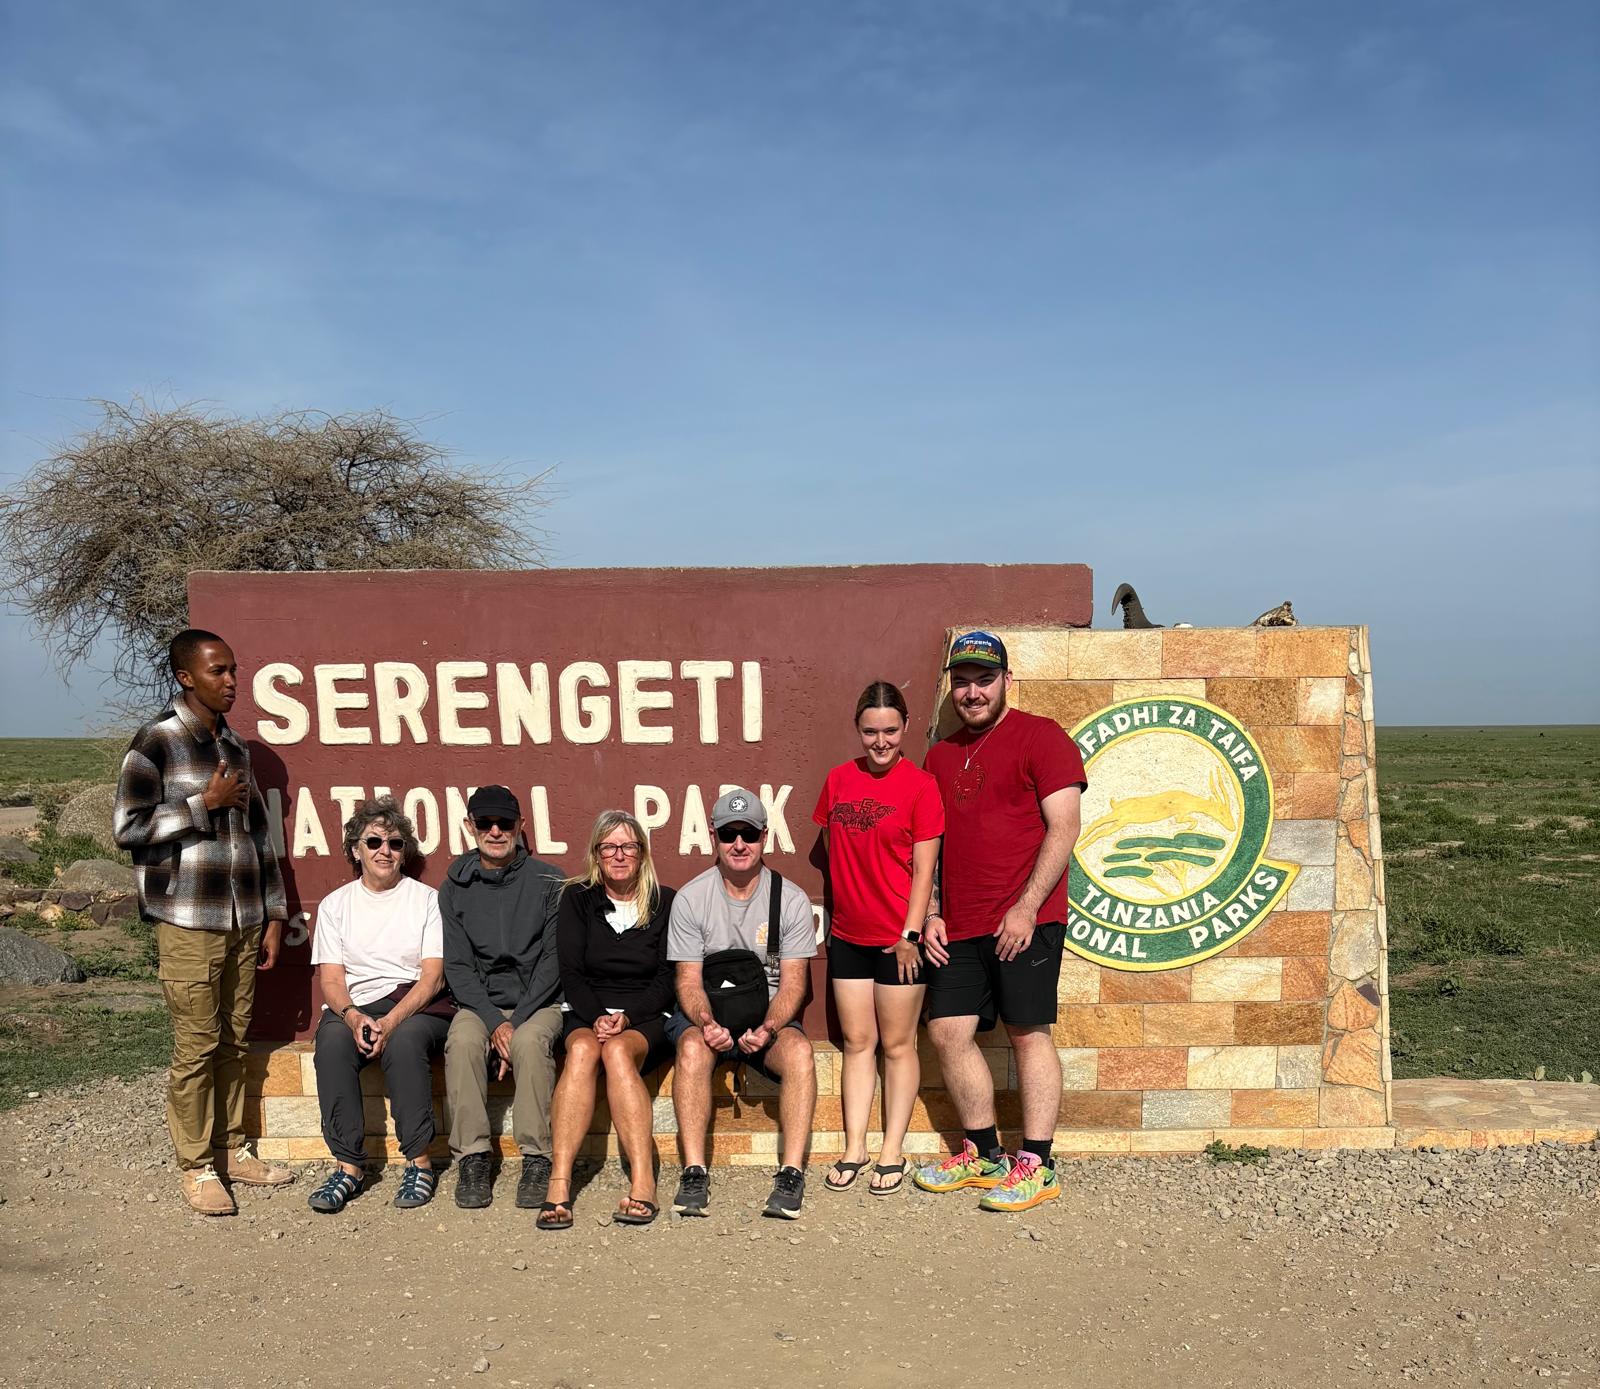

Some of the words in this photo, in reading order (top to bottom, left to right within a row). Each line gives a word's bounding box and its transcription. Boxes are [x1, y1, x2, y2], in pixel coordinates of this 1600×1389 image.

[252, 660, 764, 746] SERENGETI
[1168, 705, 1197, 728] ZA
[1207, 718, 1259, 783] TAIFA
[266, 785, 568, 858] ATONL
[1067, 907, 1148, 959] IONAL
[1188, 871, 1278, 949] PARKS
[1080, 883, 1221, 929] TANZANIA
